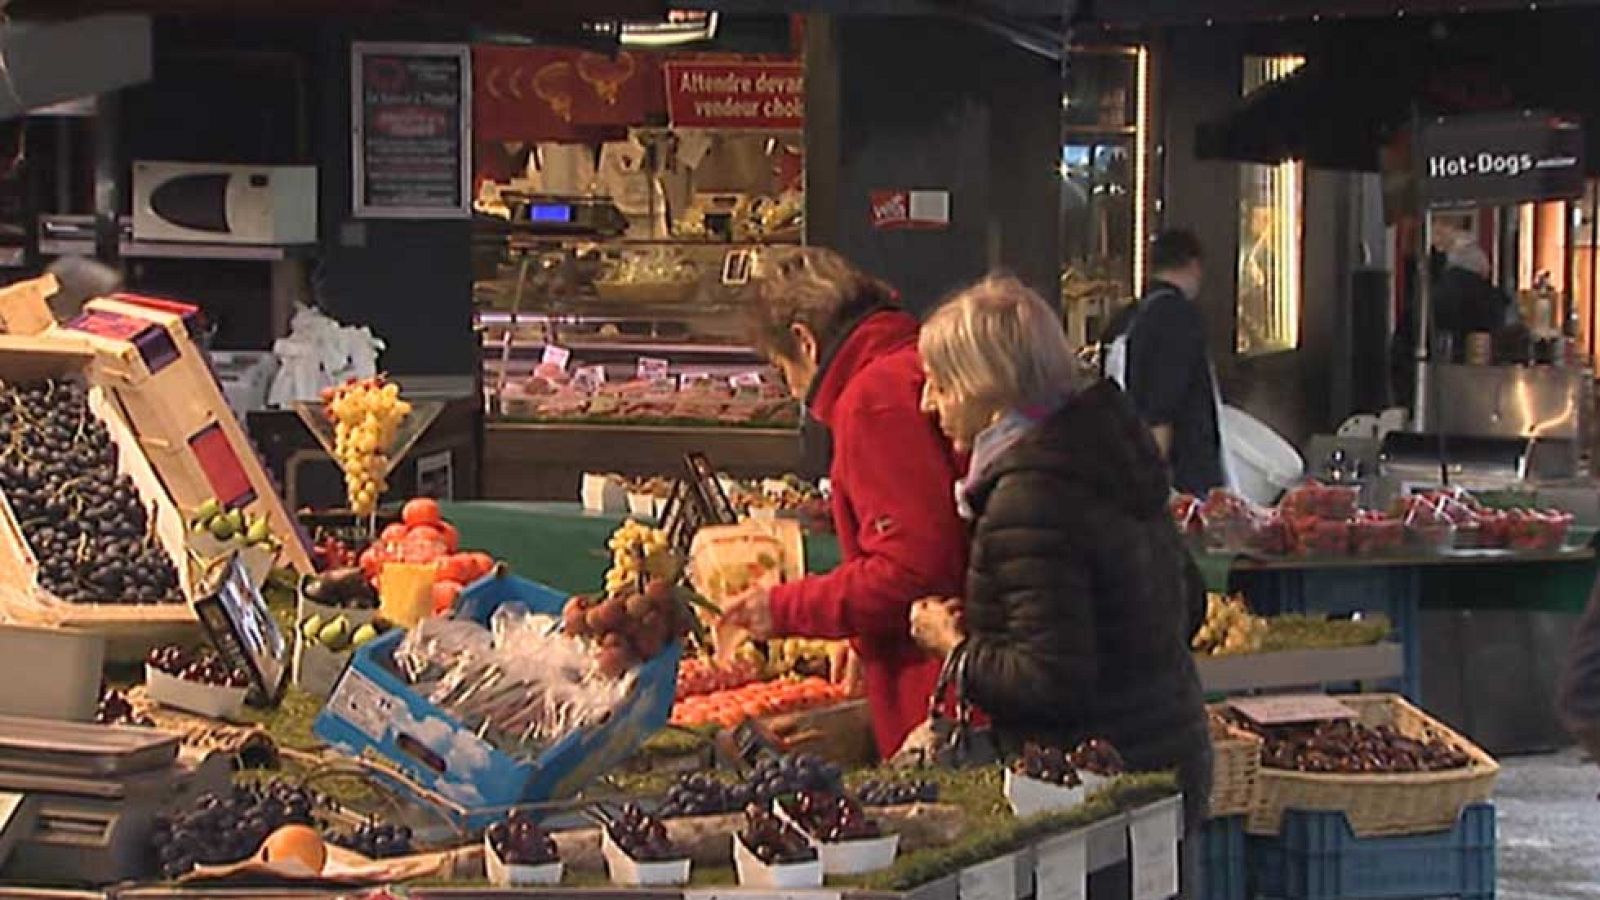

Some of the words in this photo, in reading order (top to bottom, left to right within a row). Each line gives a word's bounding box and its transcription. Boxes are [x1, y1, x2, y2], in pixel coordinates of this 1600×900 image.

[680, 71, 751, 93] Attendre
[694, 97, 760, 118] vendeur
[1429, 152, 1533, 177] Hot-Dogs
